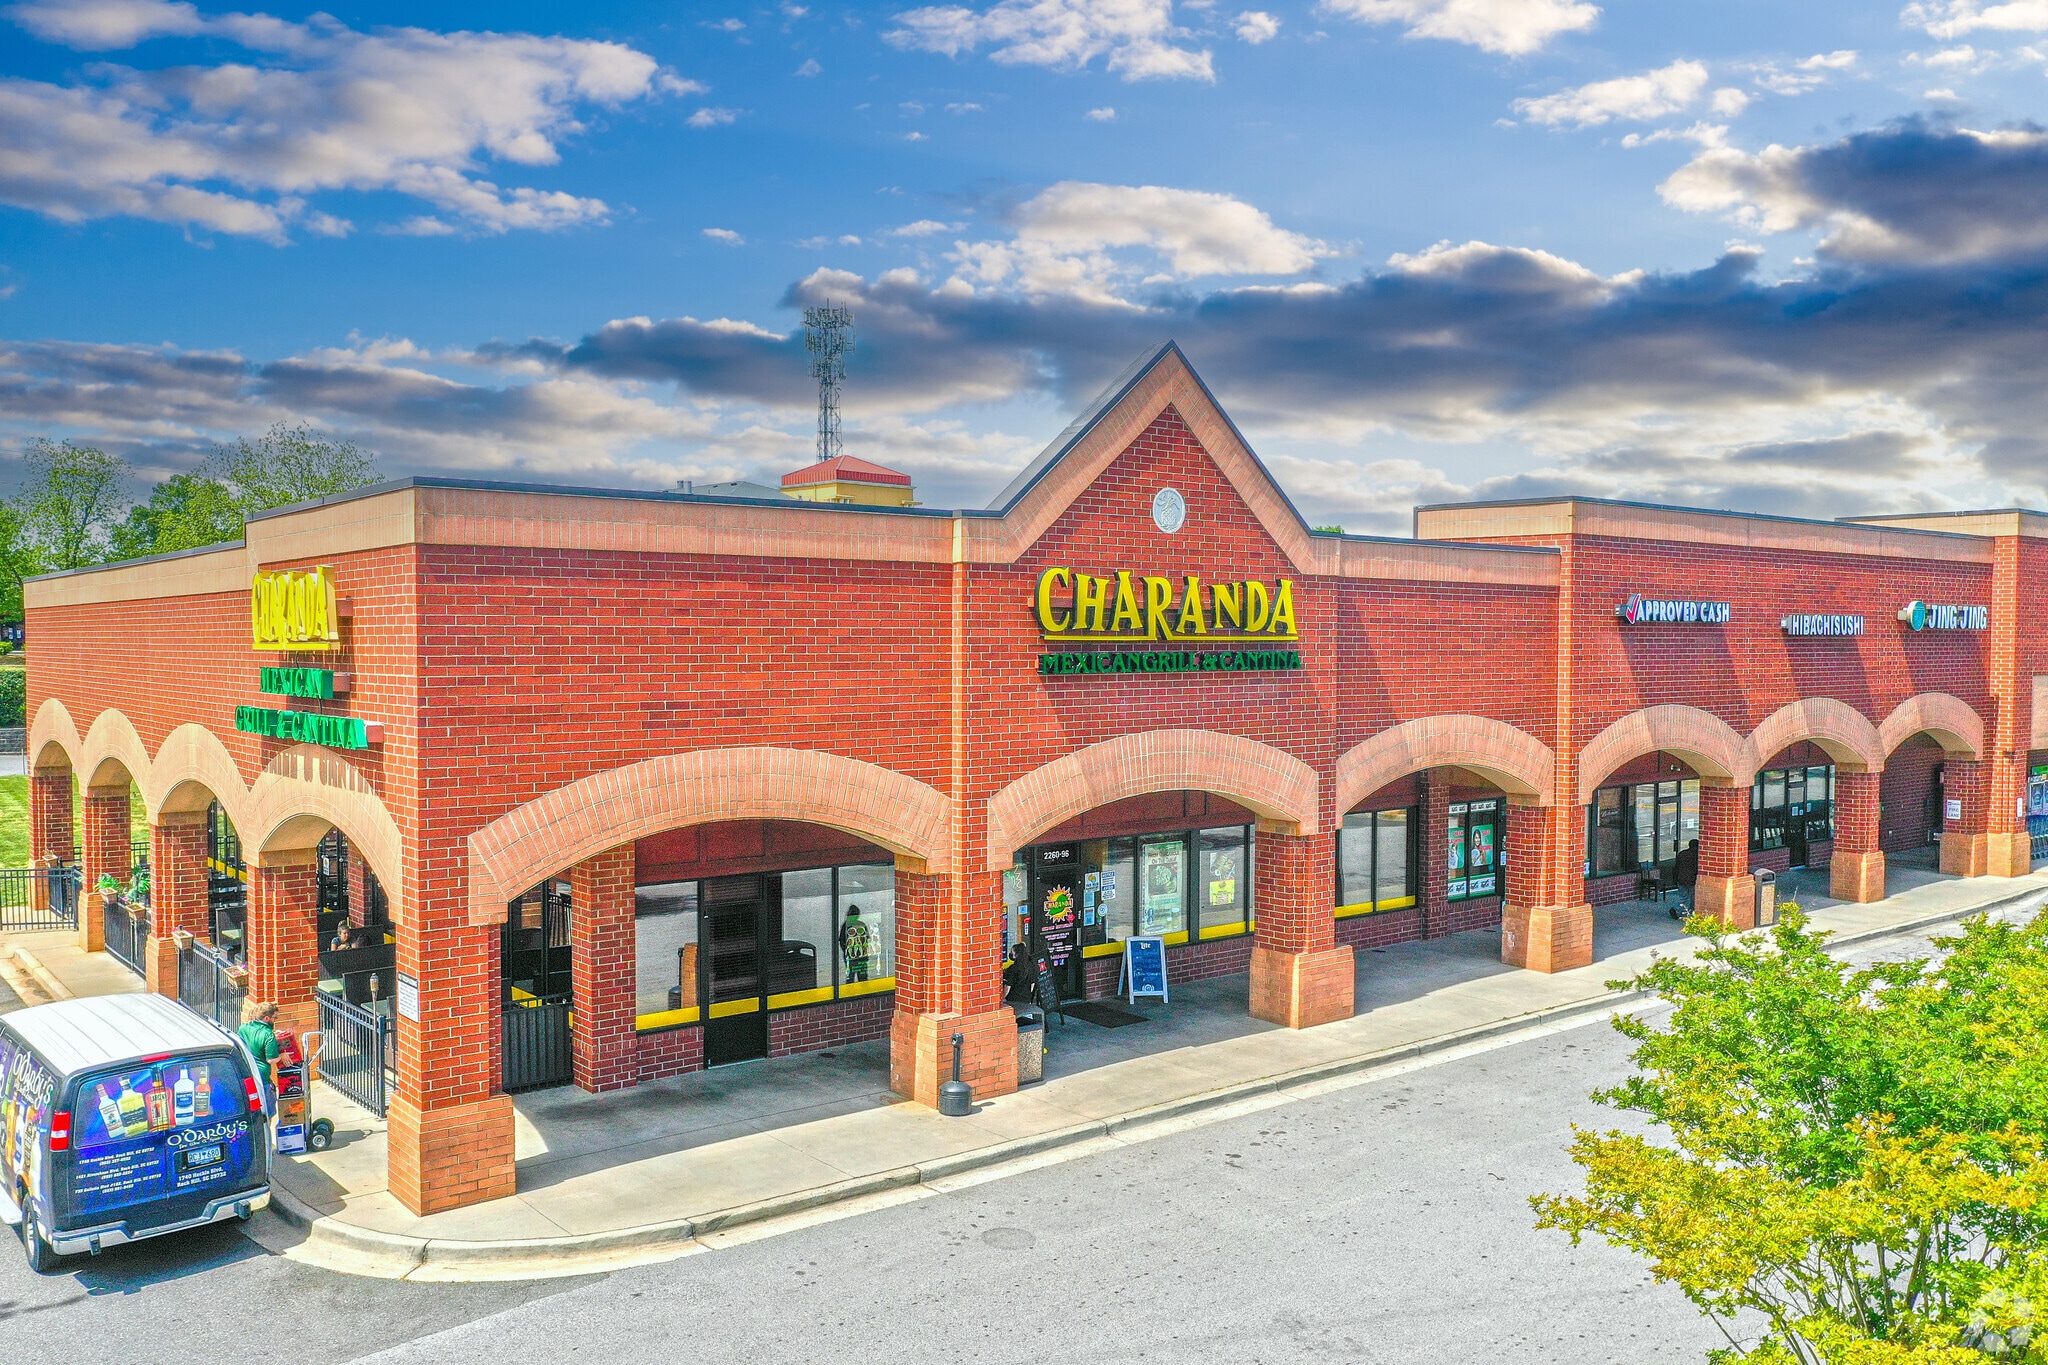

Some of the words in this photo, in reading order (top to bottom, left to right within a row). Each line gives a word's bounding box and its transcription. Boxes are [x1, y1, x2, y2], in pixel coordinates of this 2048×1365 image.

[1036, 566, 1298, 641] CHARANDA
[1636, 600, 1697, 622] APPROVED
[1700, 602, 1730, 622] CASH
[1928, 604, 1957, 629] JING
[1960, 605, 1988, 629] JING
[1219, 651, 1301, 671] CANTINA
[260, 667, 323, 699] MEXICAN
[235, 705, 272, 737] GRILL
[292, 712, 364, 749] CANTINA
[1043, 849, 1070, 860] 2260-96
